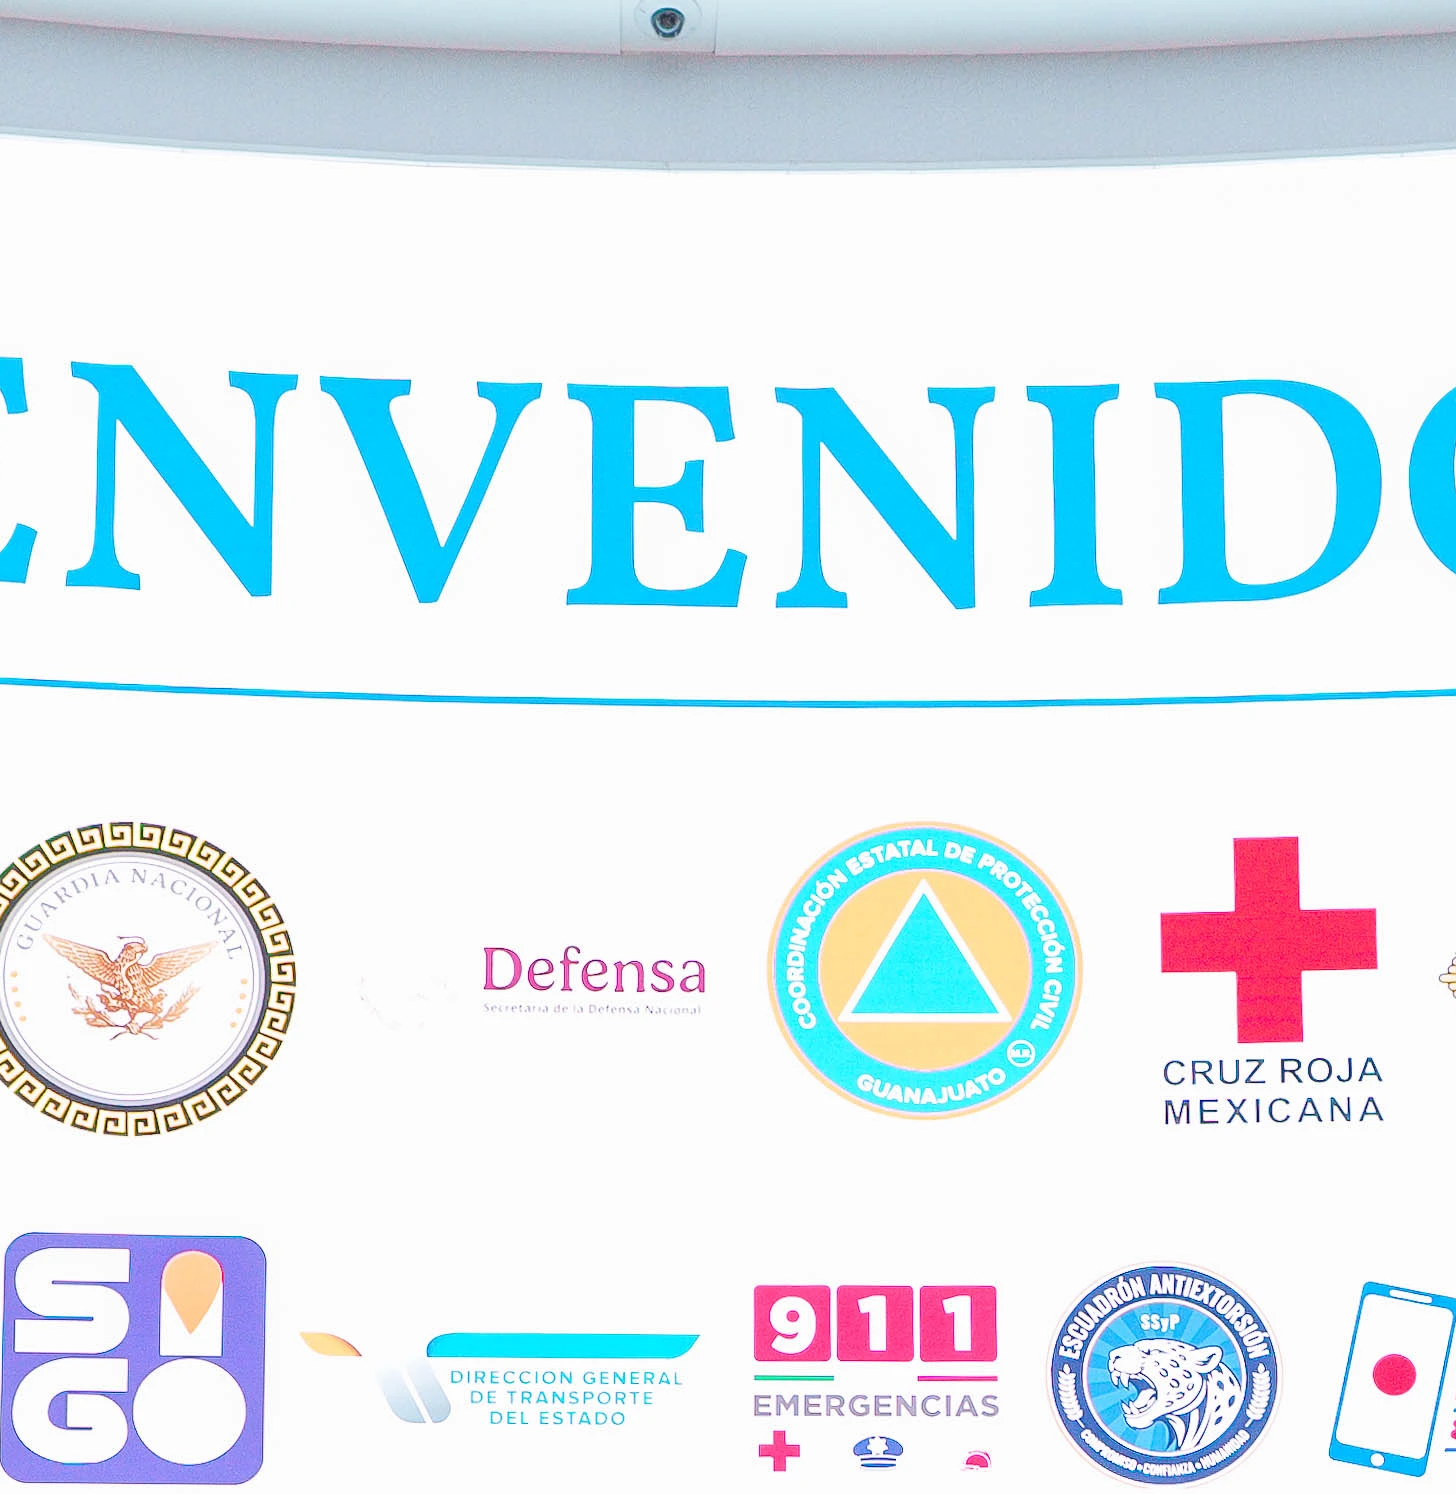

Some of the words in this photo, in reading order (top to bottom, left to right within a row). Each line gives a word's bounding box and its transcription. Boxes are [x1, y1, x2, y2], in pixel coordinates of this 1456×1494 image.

[15, 868, 121, 951] GUARDIA
[131, 867, 243, 960] NACIONAL
[786, 869, 848, 1030] COORDINACIÓN
[846, 839, 939, 876] ESTATAL
[944, 841, 976, 864] DE
[977, 853, 1065, 974] PROTECCIÓN
[1030, 979, 1062, 1030] CIVIL
[483, 945, 706, 993] Defensa
[1163, 1058, 1266, 1085] CRUZ
[1280, 1057, 1383, 1083] ROJA
[856, 1068, 1006, 1105] GUANAJUATO
[1164, 1096, 1384, 1125] MEXICANA
[769, 1295, 972, 1355] 911
[1059, 1275, 1146, 1360] ESCUADRÓN
[1149, 1273, 1270, 1359] ANTIEXTORSIÓN
[1140, 1314, 1180, 1332] SSyP
[583, 1371, 683, 1386] GENERAL
[470, 1390, 498, 1405] DE
[507, 1390, 654, 1405] TRANSPORTE
[753, 1394, 999, 1417] EMERGENCIAS
[489, 1411, 529, 1425] DEL
[540, 1411, 625, 1426] ESTADO
